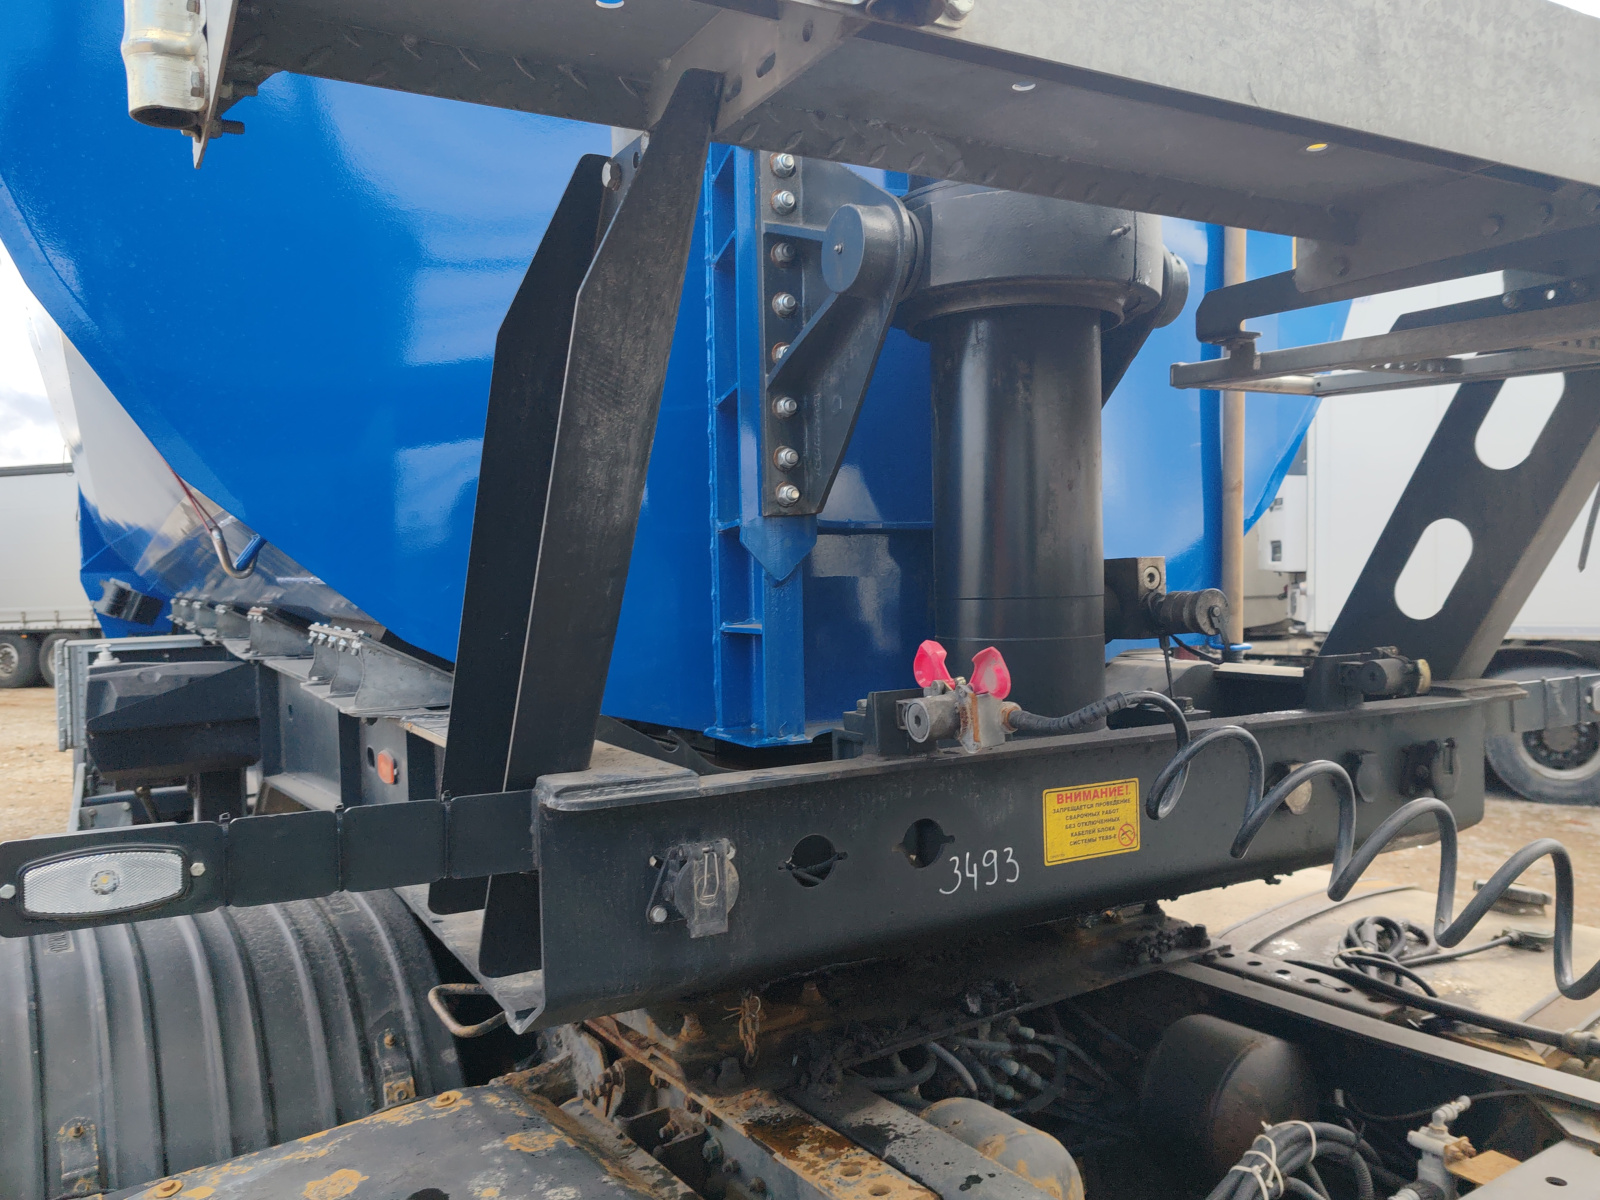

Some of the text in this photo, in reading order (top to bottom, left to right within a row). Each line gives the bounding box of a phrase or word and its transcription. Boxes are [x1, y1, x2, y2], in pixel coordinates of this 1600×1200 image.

[1056, 785, 1130, 804] ВНИМАНИЕ!
[1053, 798, 1131, 814] ЗАПРЕЩАЕТСЯ ПРОВЕДЕНИЕ
[1065, 808, 1119, 821] СВАРОЧНЫХ РАБОТ
[1077, 816, 1120, 828] ОТКЛЮЧЕННЫХ
[1070, 829, 1096, 838] КАБЕЛЕЙ
[1069, 836, 1097, 846] СИСТЕМЫ
[939, 846, 1020, 895] 3493
